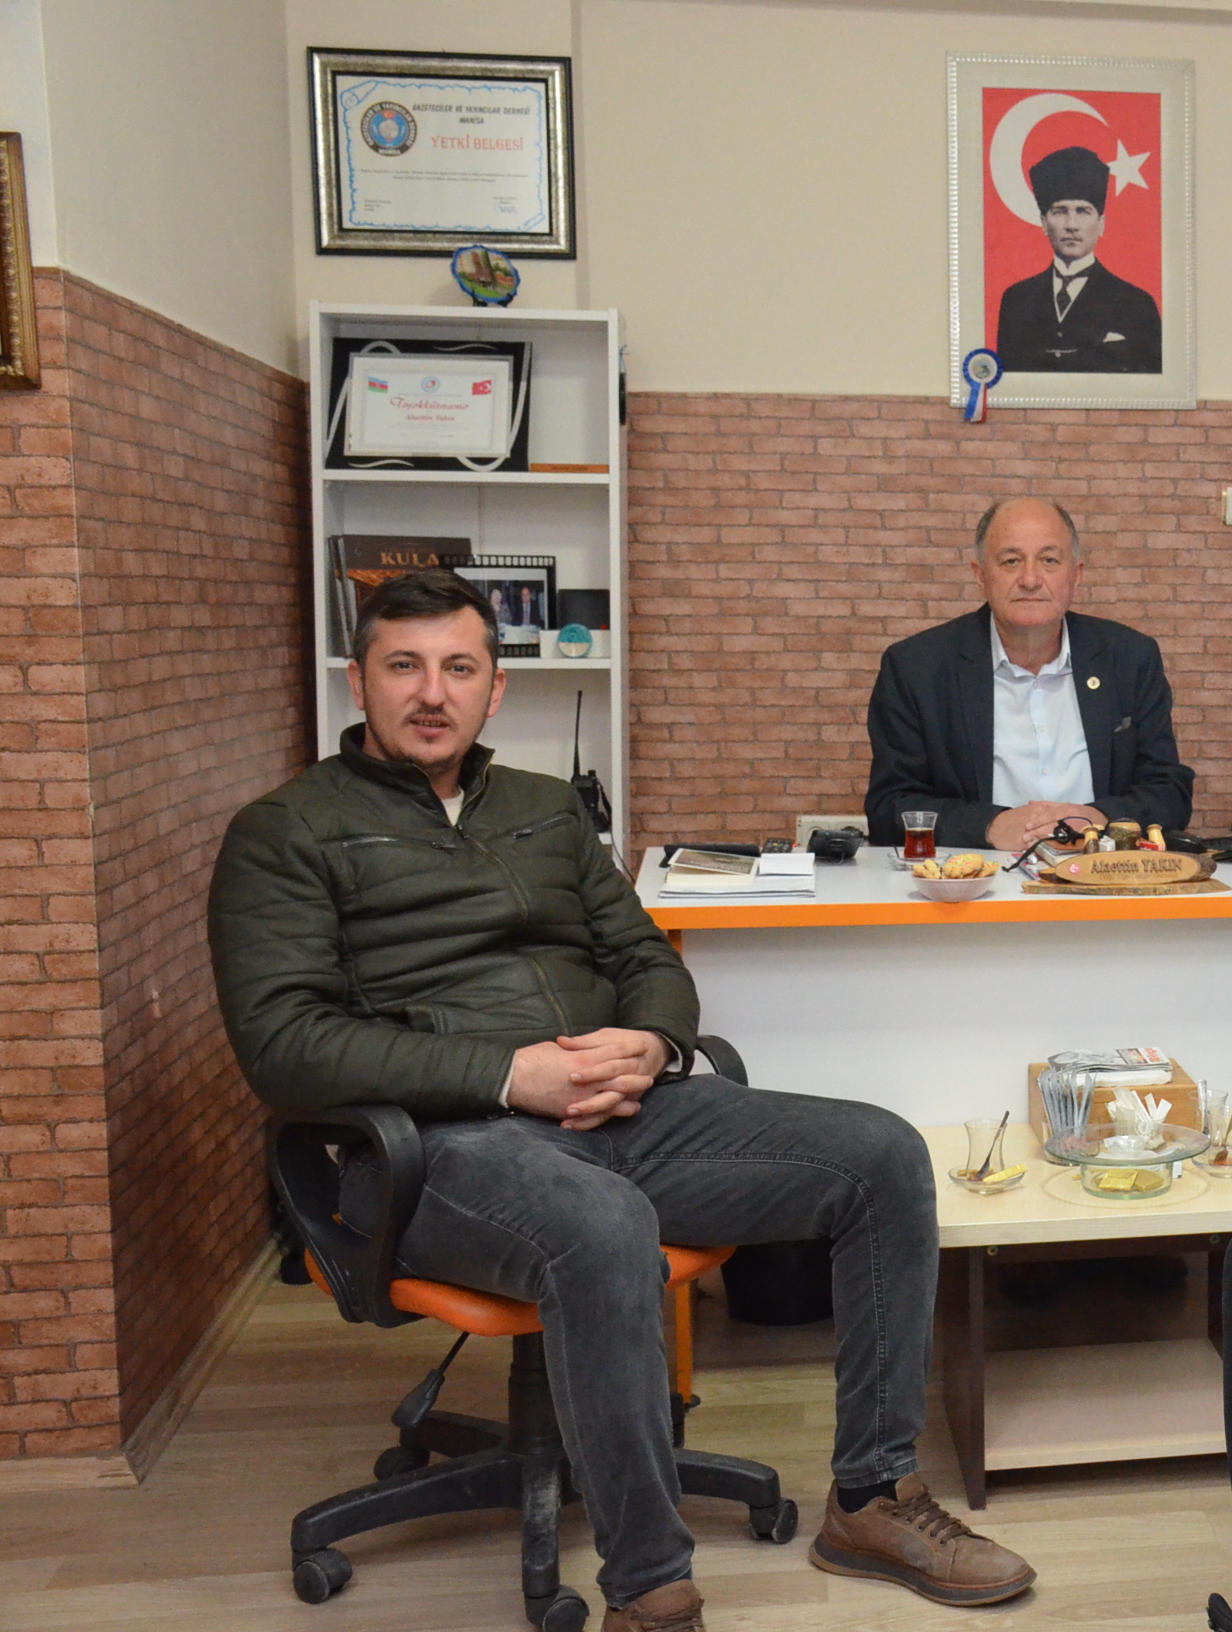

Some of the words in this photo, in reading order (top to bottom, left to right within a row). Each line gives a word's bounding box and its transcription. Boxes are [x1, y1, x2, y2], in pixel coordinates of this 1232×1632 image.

[431, 134, 471, 150] YETKİ
[474, 136, 525, 151] BELGESİ
[381, 552, 440, 568] KULA
[1141, 858, 1182, 872] YAKIN
